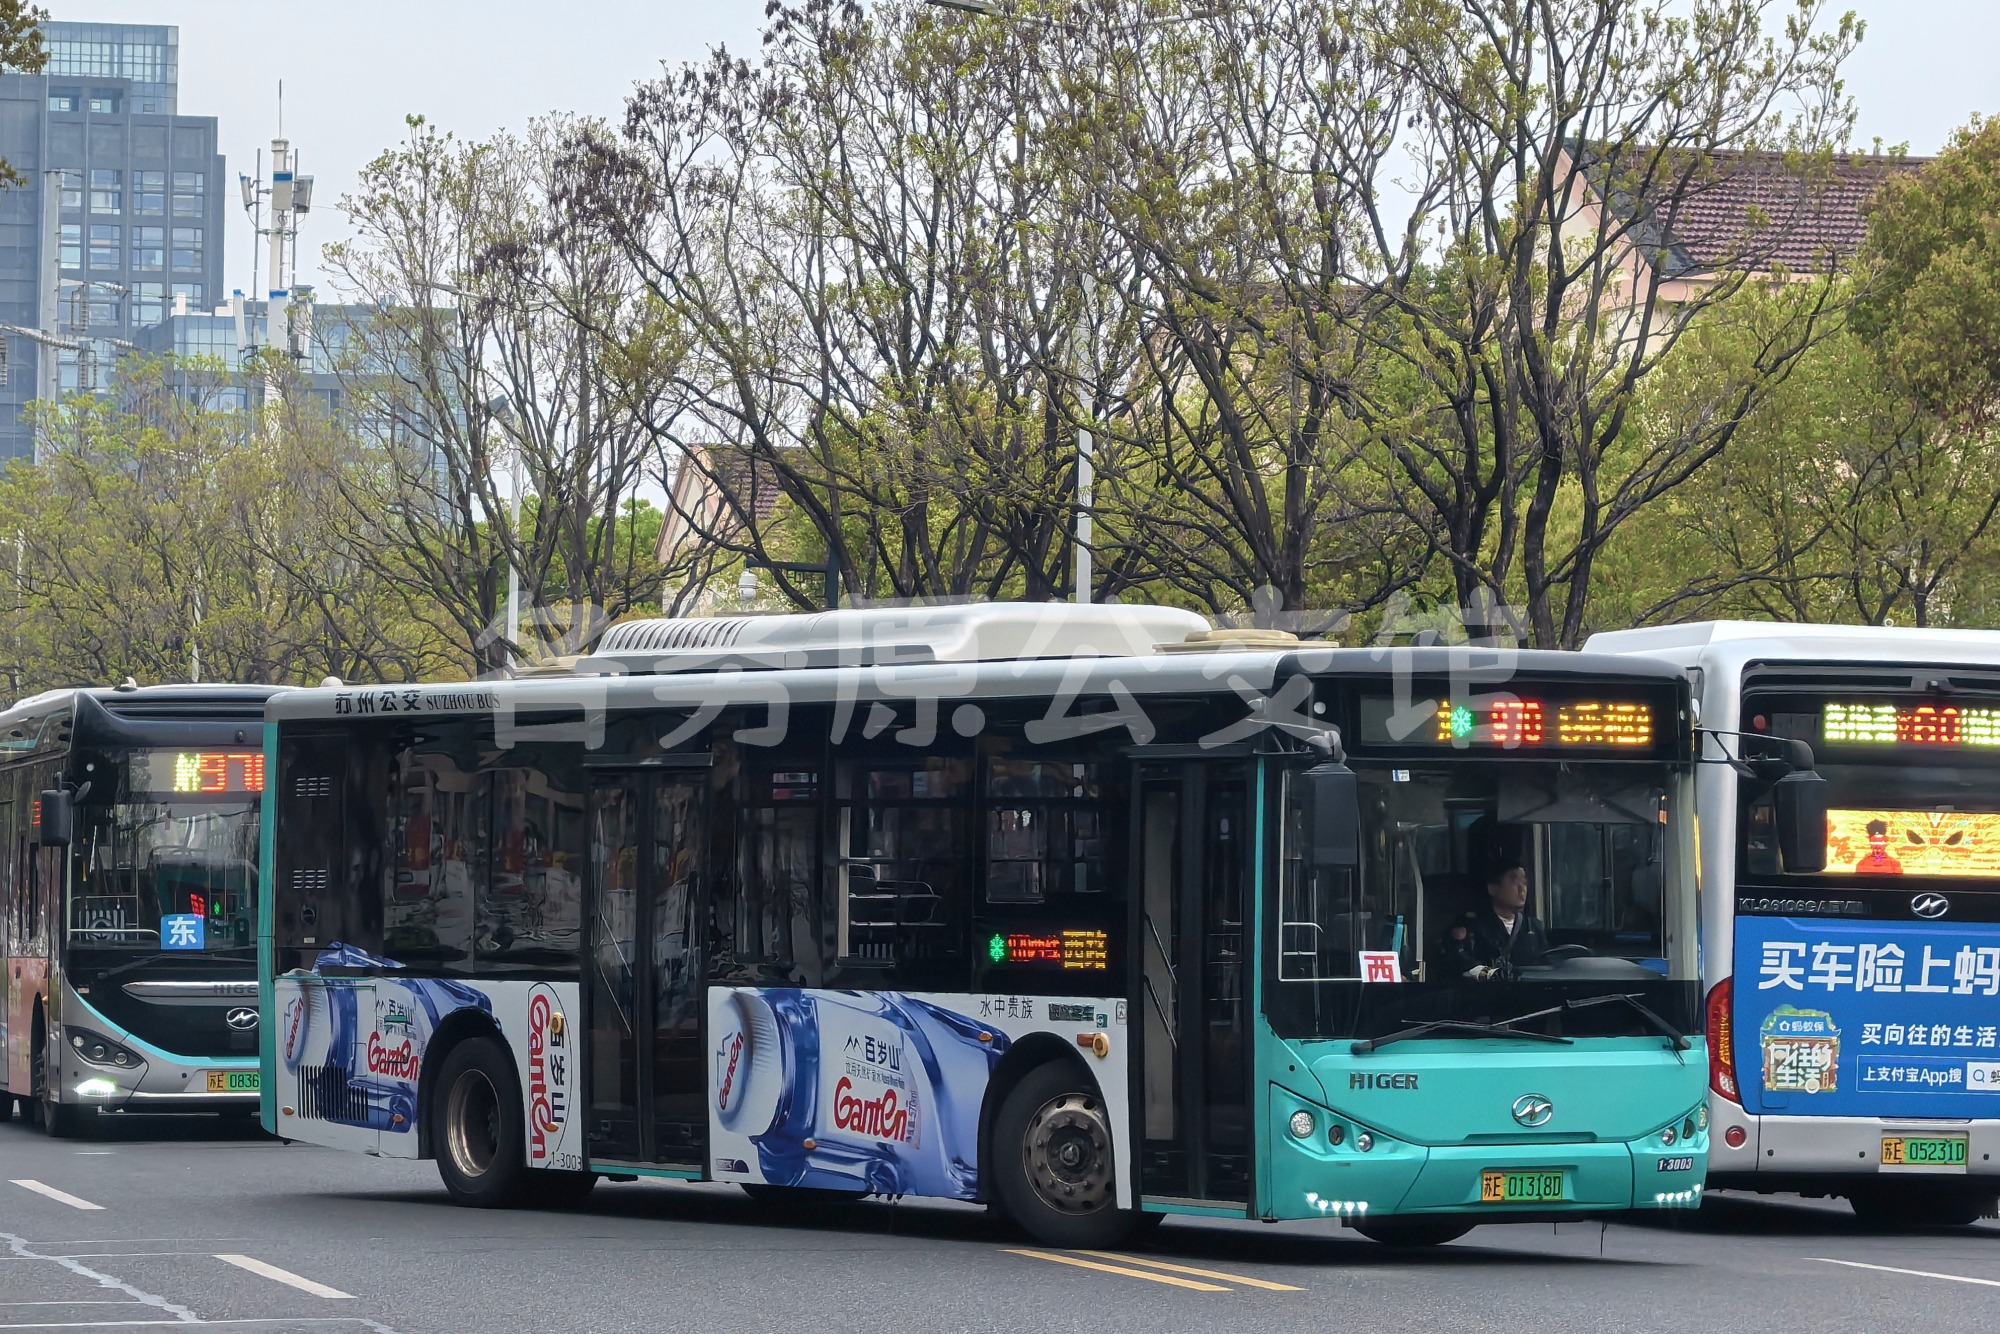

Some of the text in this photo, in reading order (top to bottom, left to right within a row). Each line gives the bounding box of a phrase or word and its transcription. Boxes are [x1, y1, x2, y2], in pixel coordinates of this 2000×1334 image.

[335, 689, 422, 714] 苏州公交
[426, 692, 501, 710] SUZHOU BUS
[168, 916, 197, 946] 东
[1363, 955, 1395, 982] 西
[1758, 941, 2000, 996] 买车险上蚂
[213, 983, 258, 995] HIGE
[980, 996, 1034, 1020] 水中贵族
[1791, 1020, 1825, 1033] 蚂蚁保
[1860, 1023, 1997, 1048] 买向往的生活
[367, 1031, 419, 1081] Ganten
[864, 1035, 902, 1071] 百岁山
[529, 994, 554, 1159] Ganten
[1349, 1072, 1419, 1090] HIGER
[1776, 1065, 1821, 1094] 生活
[1862, 1067, 1962, 1087] 上支付宝App搜
[834, 1076, 908, 1142] Ganten
[550, 1150, 582, 1171] 1-3003
